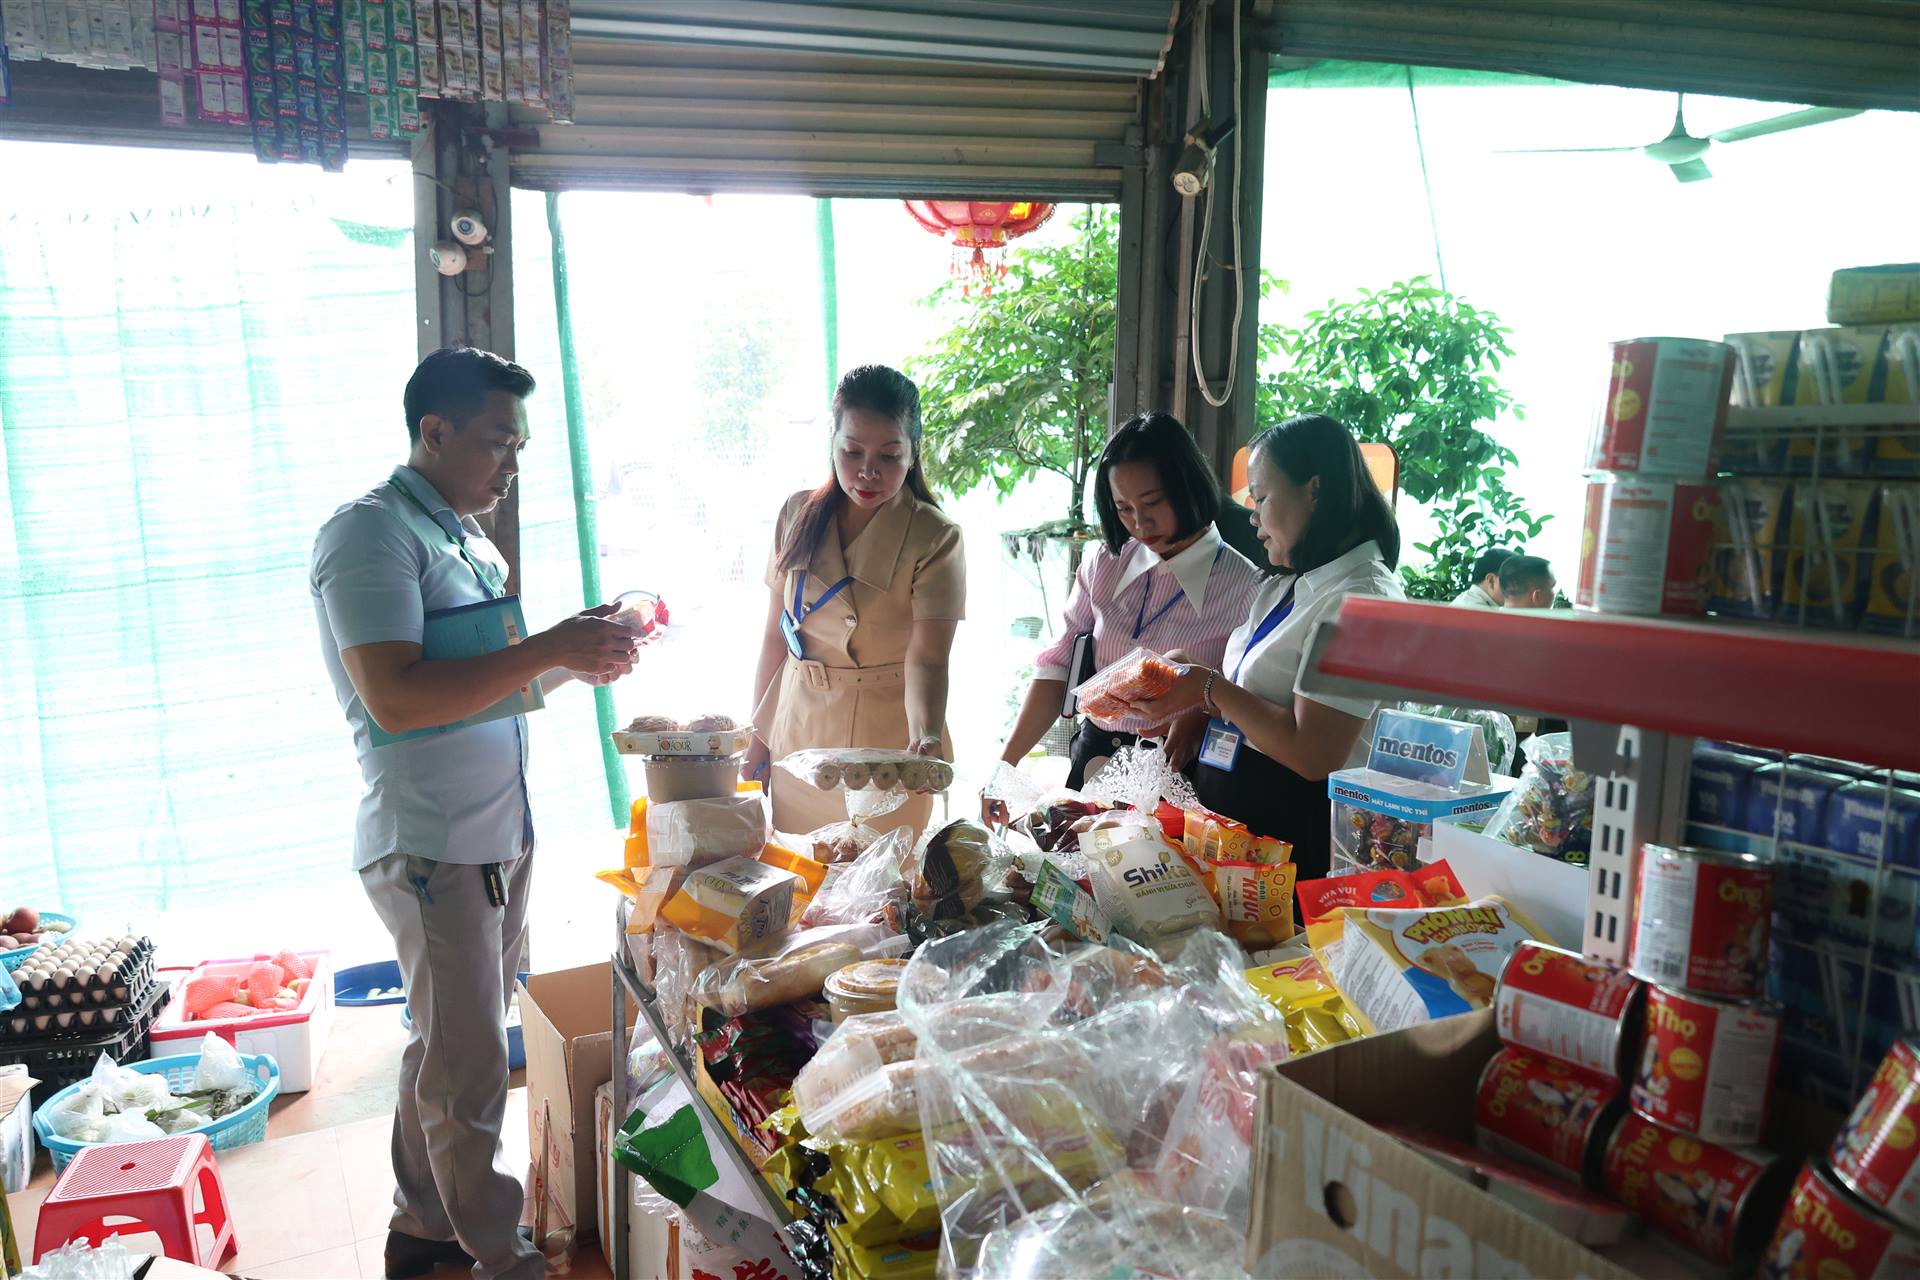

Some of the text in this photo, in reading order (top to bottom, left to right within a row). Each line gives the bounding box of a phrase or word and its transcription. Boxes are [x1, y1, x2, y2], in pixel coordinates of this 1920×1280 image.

[1377, 735, 1459, 769] mentos
[1334, 787, 1370, 803] mentos
[1453, 801, 1491, 816] mentos
